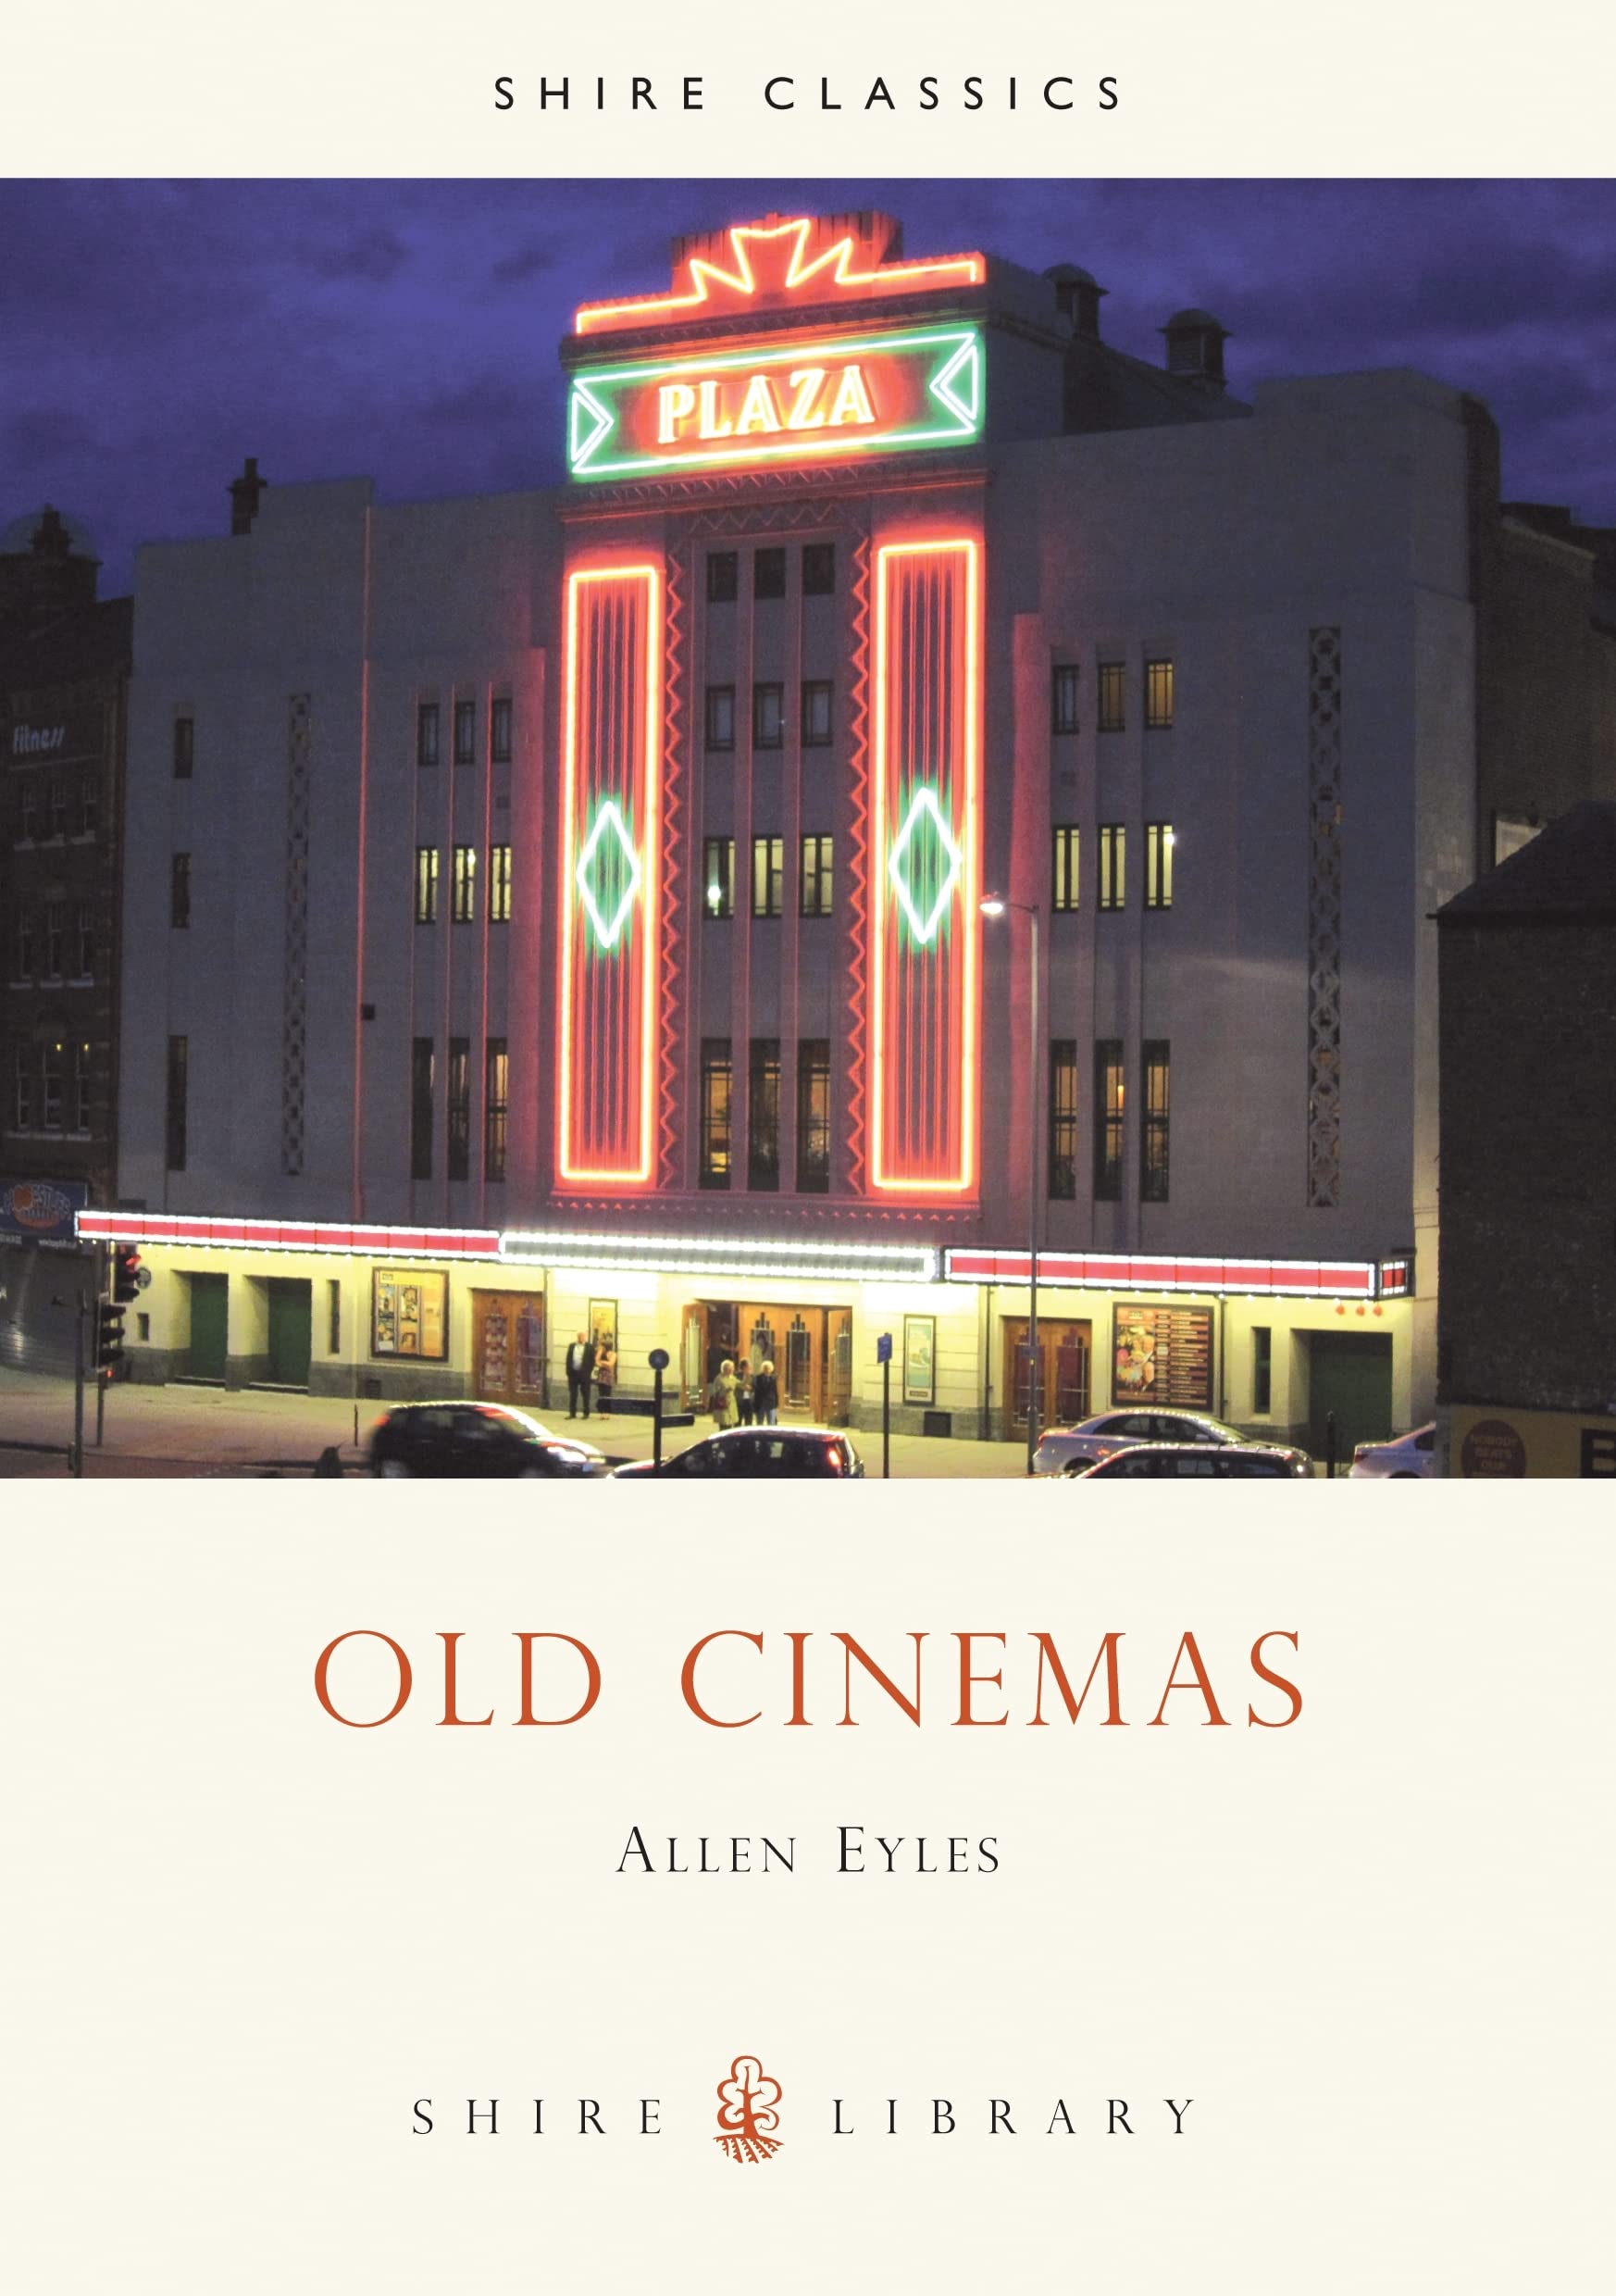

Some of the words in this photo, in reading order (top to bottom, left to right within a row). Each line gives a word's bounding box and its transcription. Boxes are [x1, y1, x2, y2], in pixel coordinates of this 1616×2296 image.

[494, 76, 703, 110] SHIRE
[764, 76, 1118, 110] CLASSICS
[657, 365, 876, 444] PLAZA
[314, 1629, 602, 1728] OLD
[680, 1629, 1303, 1728] CINEMAS
[413, 2098, 661, 2135] SHIRE
[832, 2098, 1195, 2135] LIBRARY
